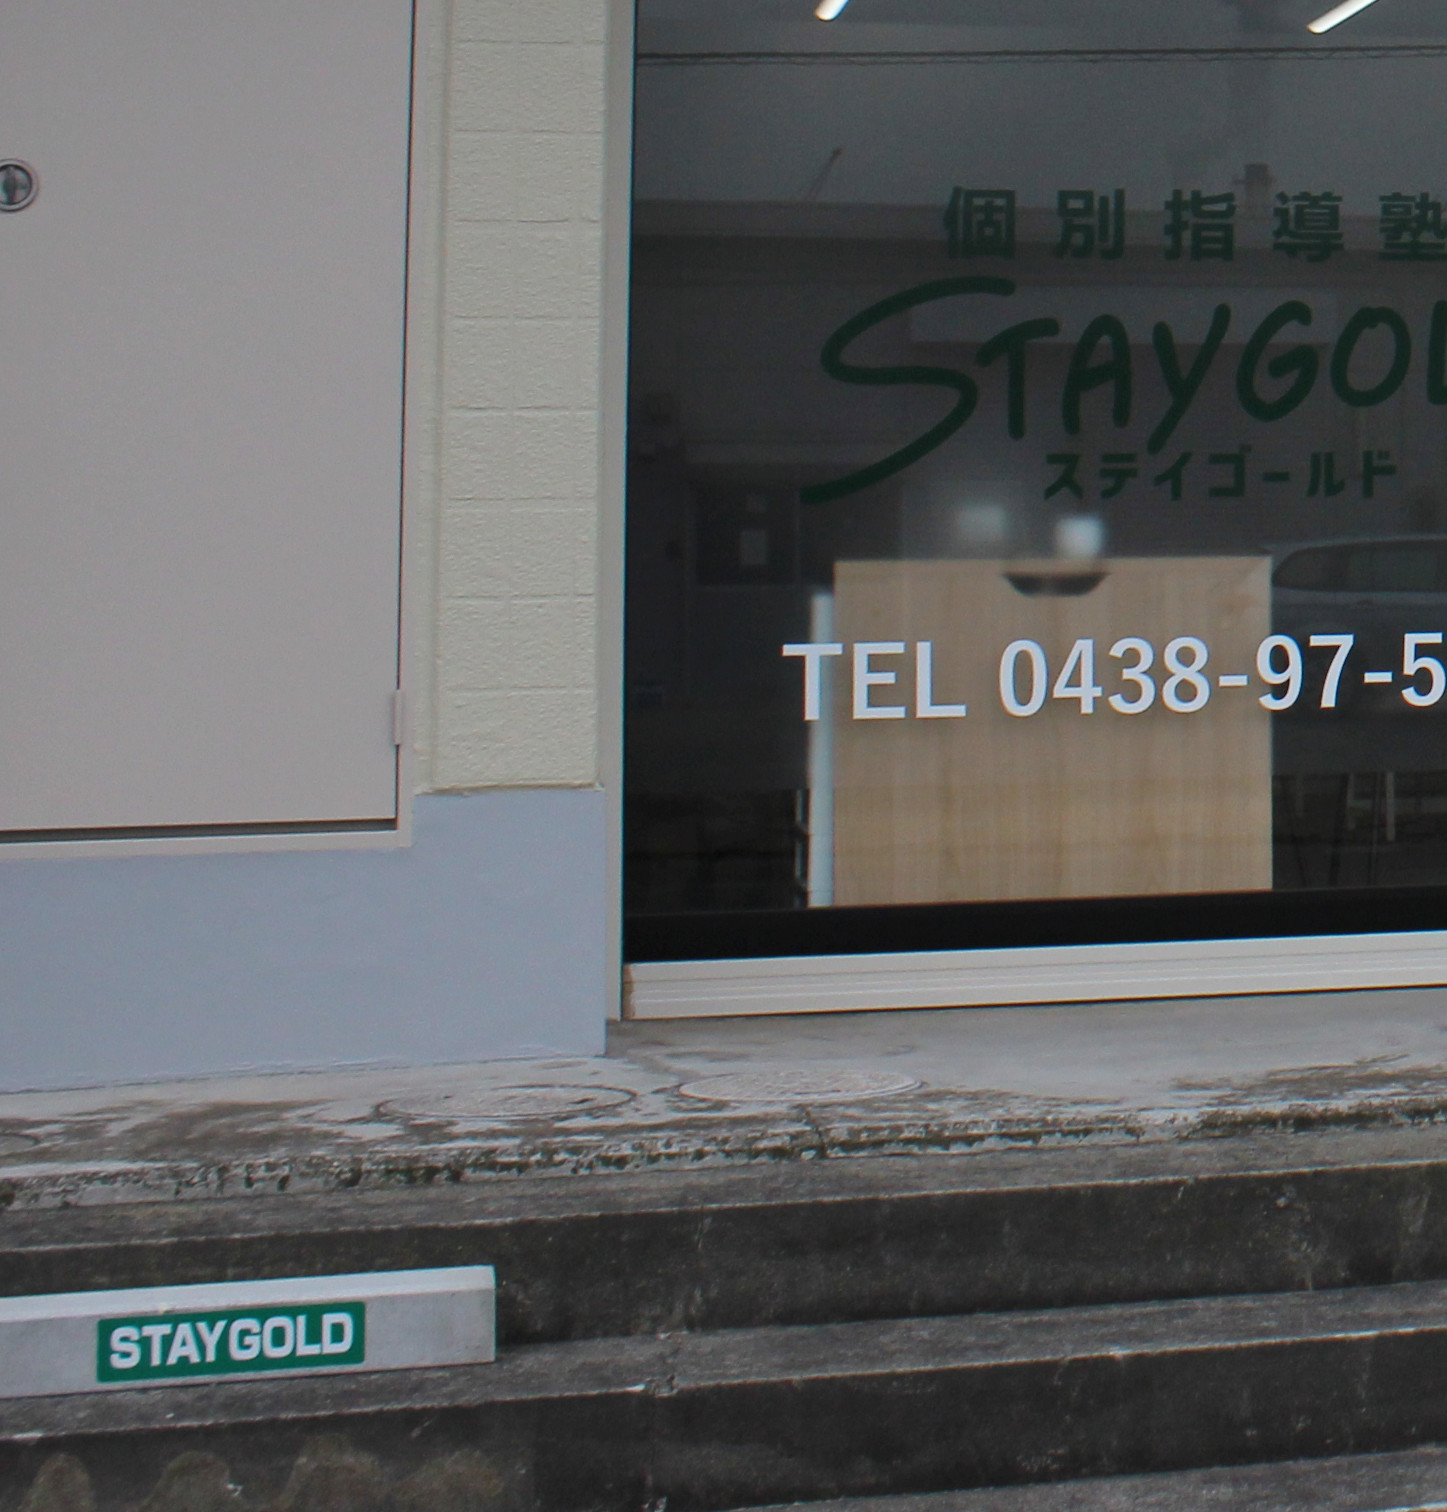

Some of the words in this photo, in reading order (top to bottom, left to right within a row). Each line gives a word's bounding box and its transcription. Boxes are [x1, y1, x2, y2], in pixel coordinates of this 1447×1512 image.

[1042, 444, 1398, 501] ステイゴールド
[781, 639, 968, 721] TEL
[109, 1311, 355, 1370] STAYGOLD
